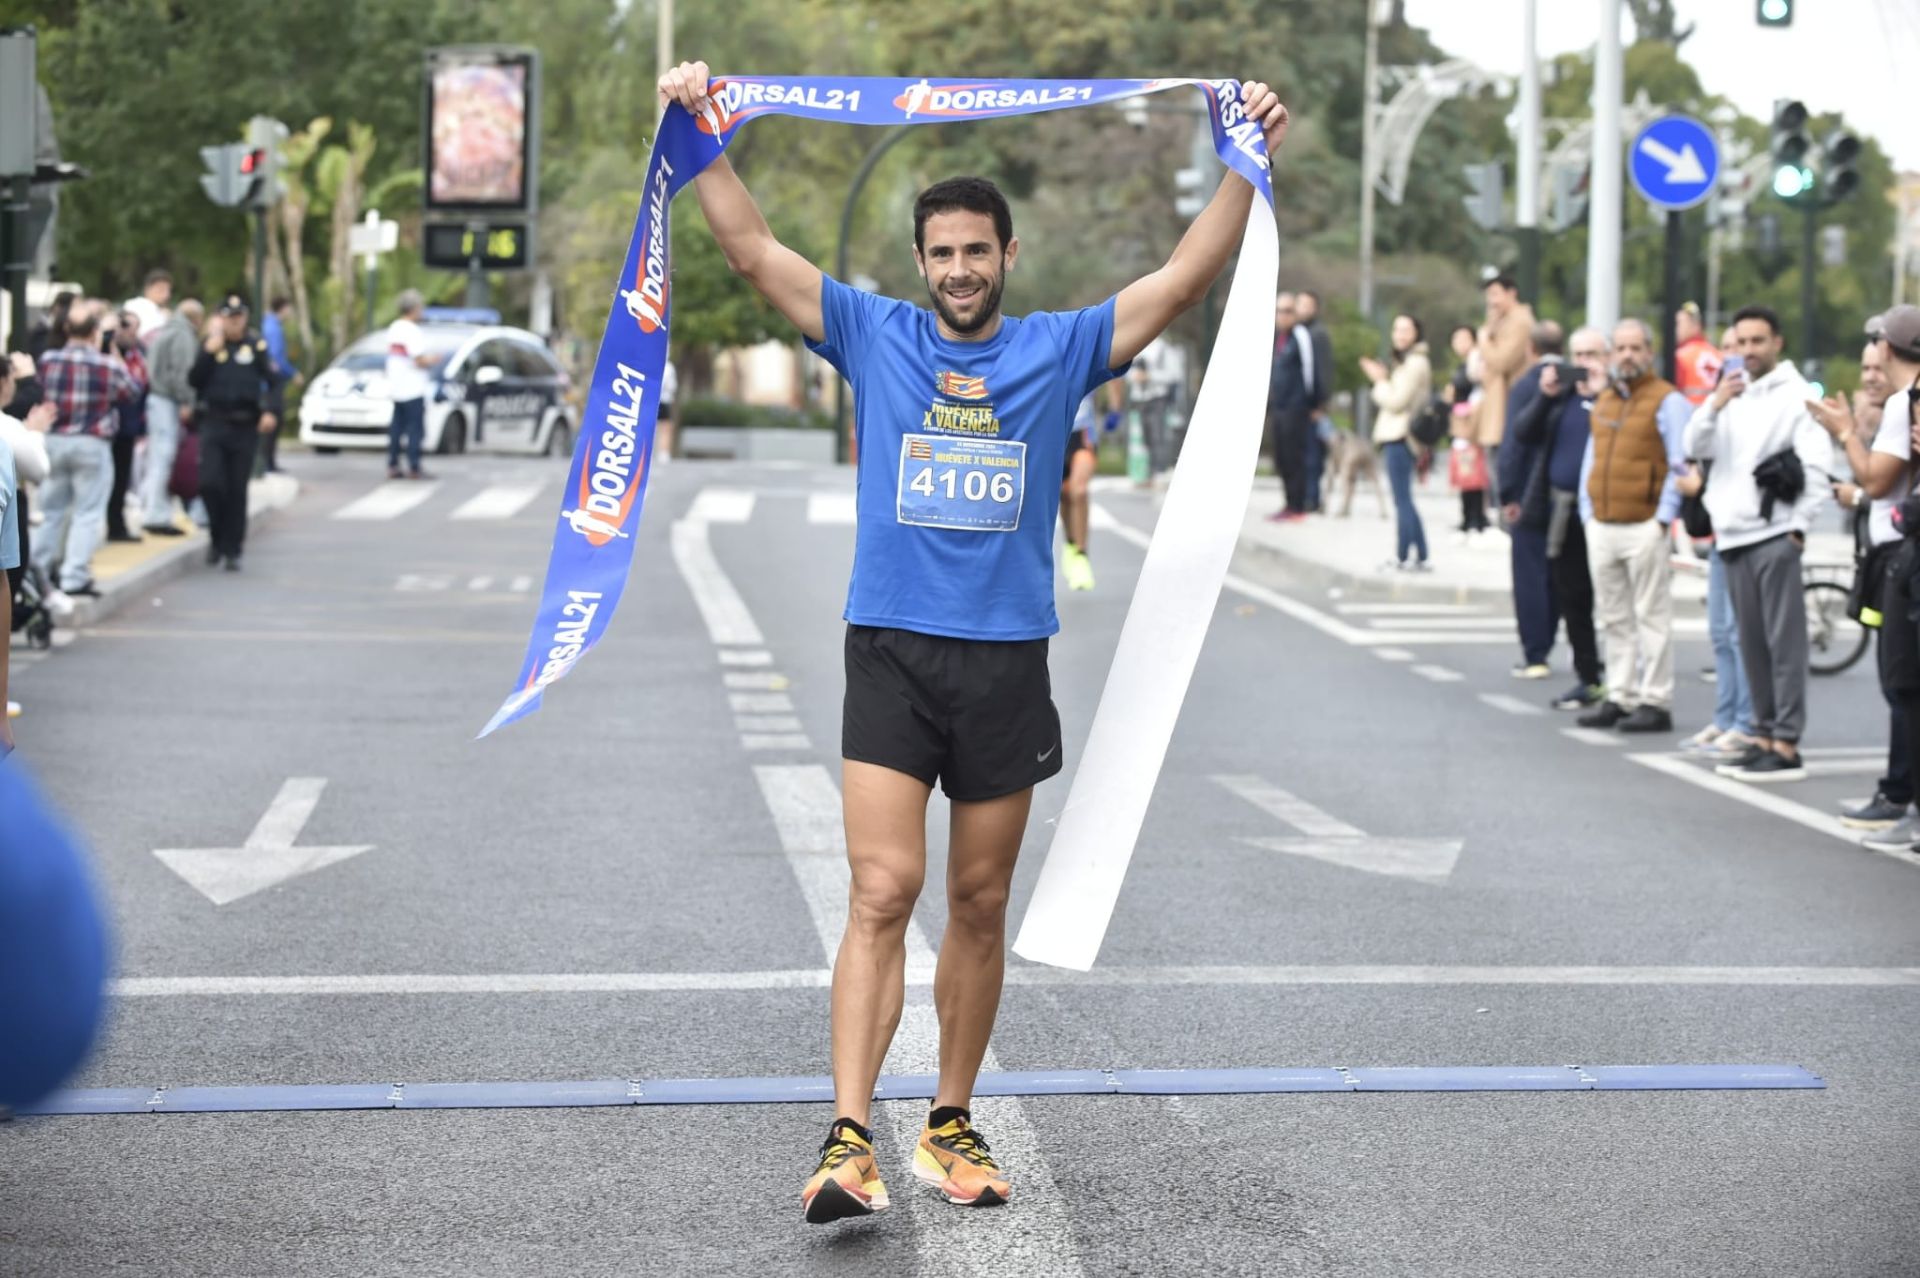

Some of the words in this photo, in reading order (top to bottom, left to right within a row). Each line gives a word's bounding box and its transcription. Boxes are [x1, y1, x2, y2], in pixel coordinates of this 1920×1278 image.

[711, 82, 861, 123] DORSAL21
[929, 87, 1093, 111] DORSAL21
[641, 154, 674, 306] DORSAL21
[586, 362, 646, 518] DORSAL21
[936, 412, 1000, 433] VALENCIA
[910, 467, 1014, 503] 4106
